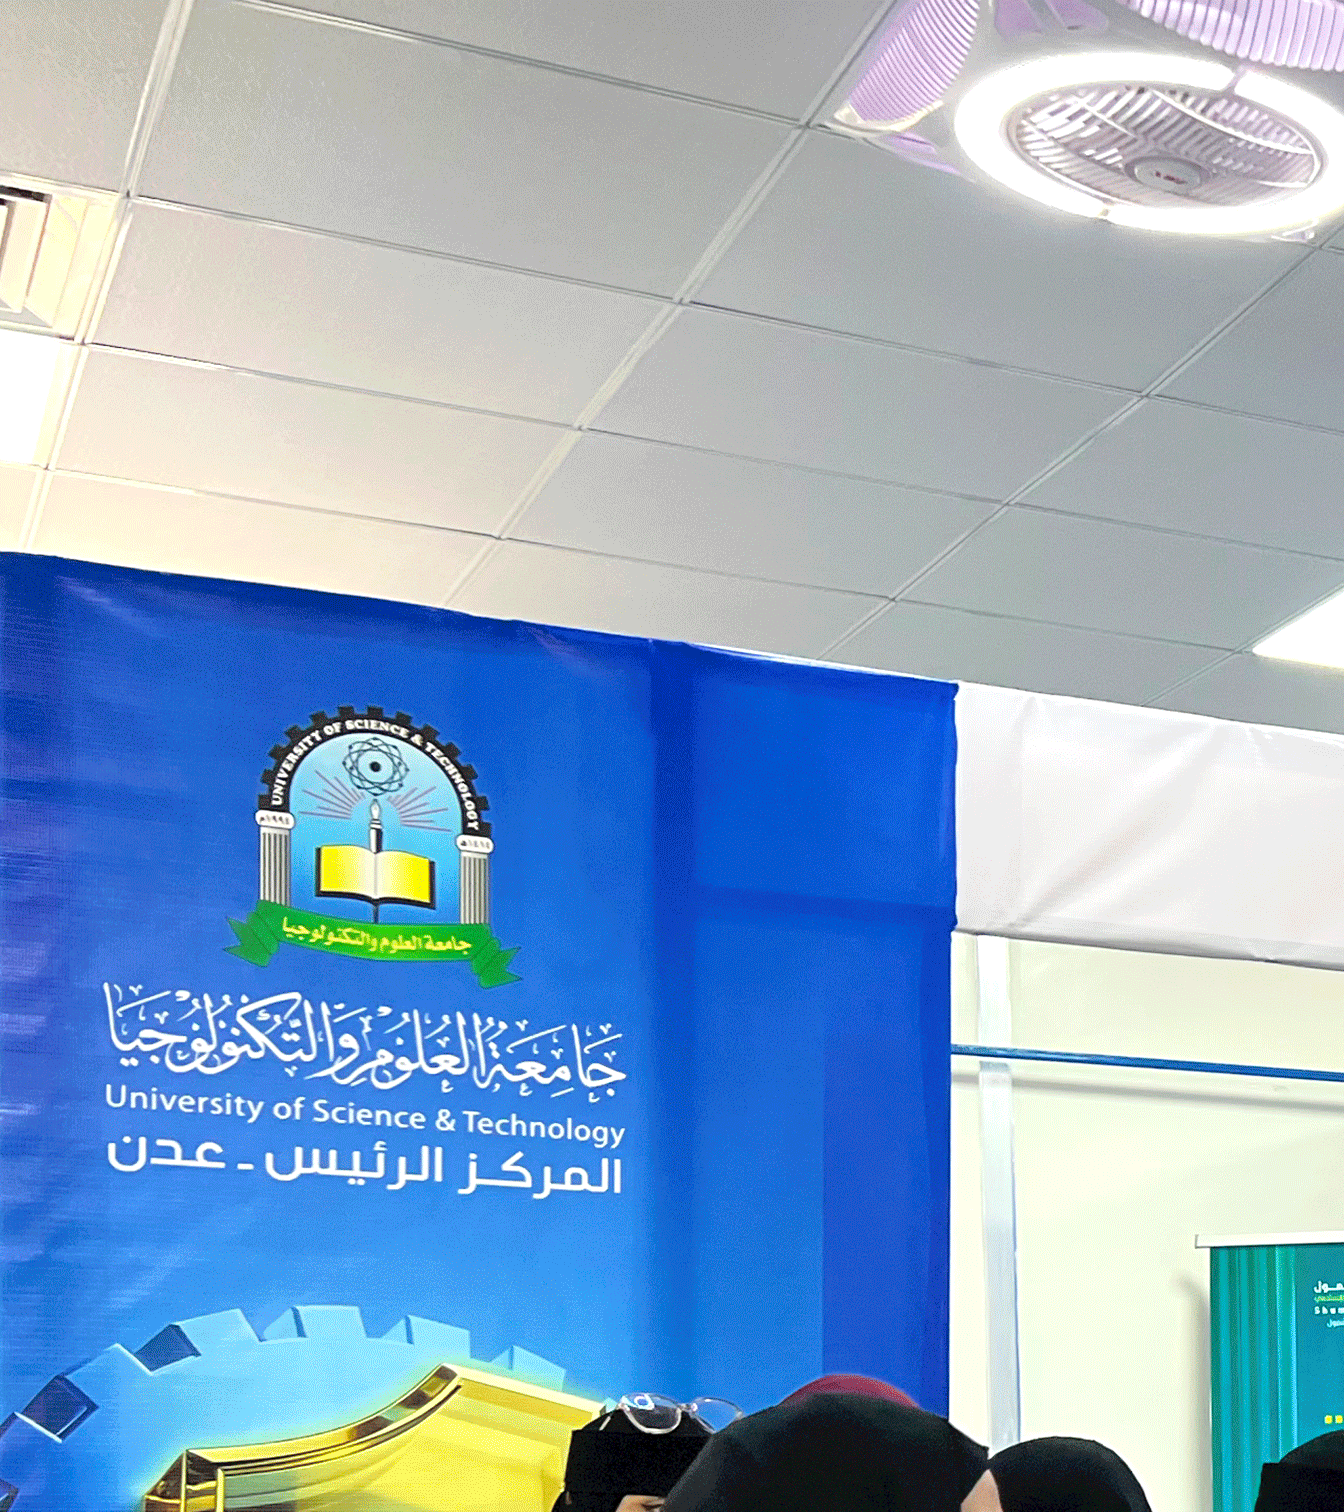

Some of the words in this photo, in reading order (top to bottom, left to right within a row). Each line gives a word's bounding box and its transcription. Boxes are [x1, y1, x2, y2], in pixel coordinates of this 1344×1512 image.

[271, 731, 323, 806] UNIVERSITY
[323, 722, 343, 736] OF
[345, 719, 409, 739] SCIENCE
[410, 732, 425, 746] &
[424, 742, 479, 831] TECHNOLOGY
[105, 1083, 265, 1124] University
[273, 1095, 306, 1121] of
[313, 1101, 427, 1131] Science
[435, 1108, 456, 1132] &
[463, 1110, 626, 1149] Technology
[106, 1134, 226, 1173] عدن
[265, 1139, 443, 1190] الرئيس
[458, 1150, 623, 1200] المركز
